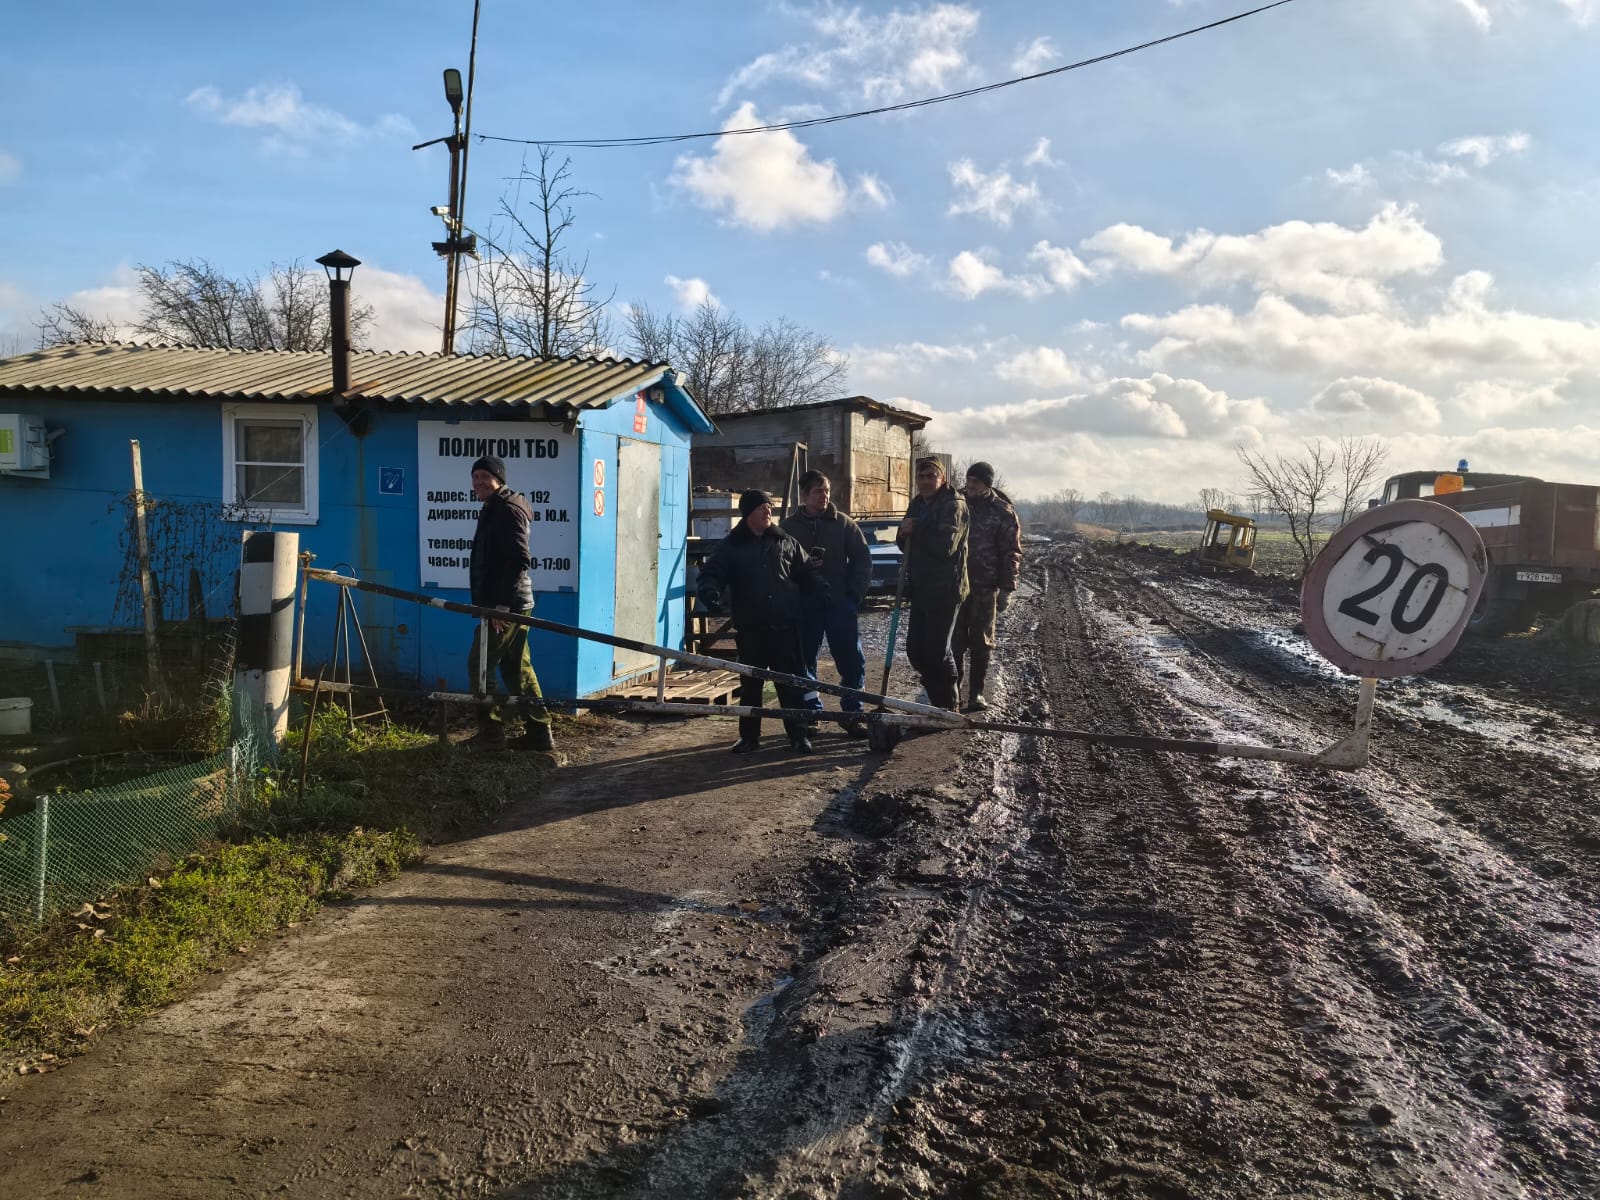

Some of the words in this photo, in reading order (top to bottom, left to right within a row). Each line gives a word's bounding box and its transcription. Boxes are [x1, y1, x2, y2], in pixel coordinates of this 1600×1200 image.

[439, 437, 521, 458] ПОЛИГОН
[525, 439, 559, 459] ТБО
[427, 490, 468, 503] адрес:
[530, 491, 551, 504] 192
[427, 508, 479, 521] директо
[545, 509, 571, 523] Ю.И.
[427, 538, 474, 551] телефо
[428, 556, 460, 568] часы
[528, 557, 571, 571] 0-17:00
[1338, 543, 1450, 635] 20
